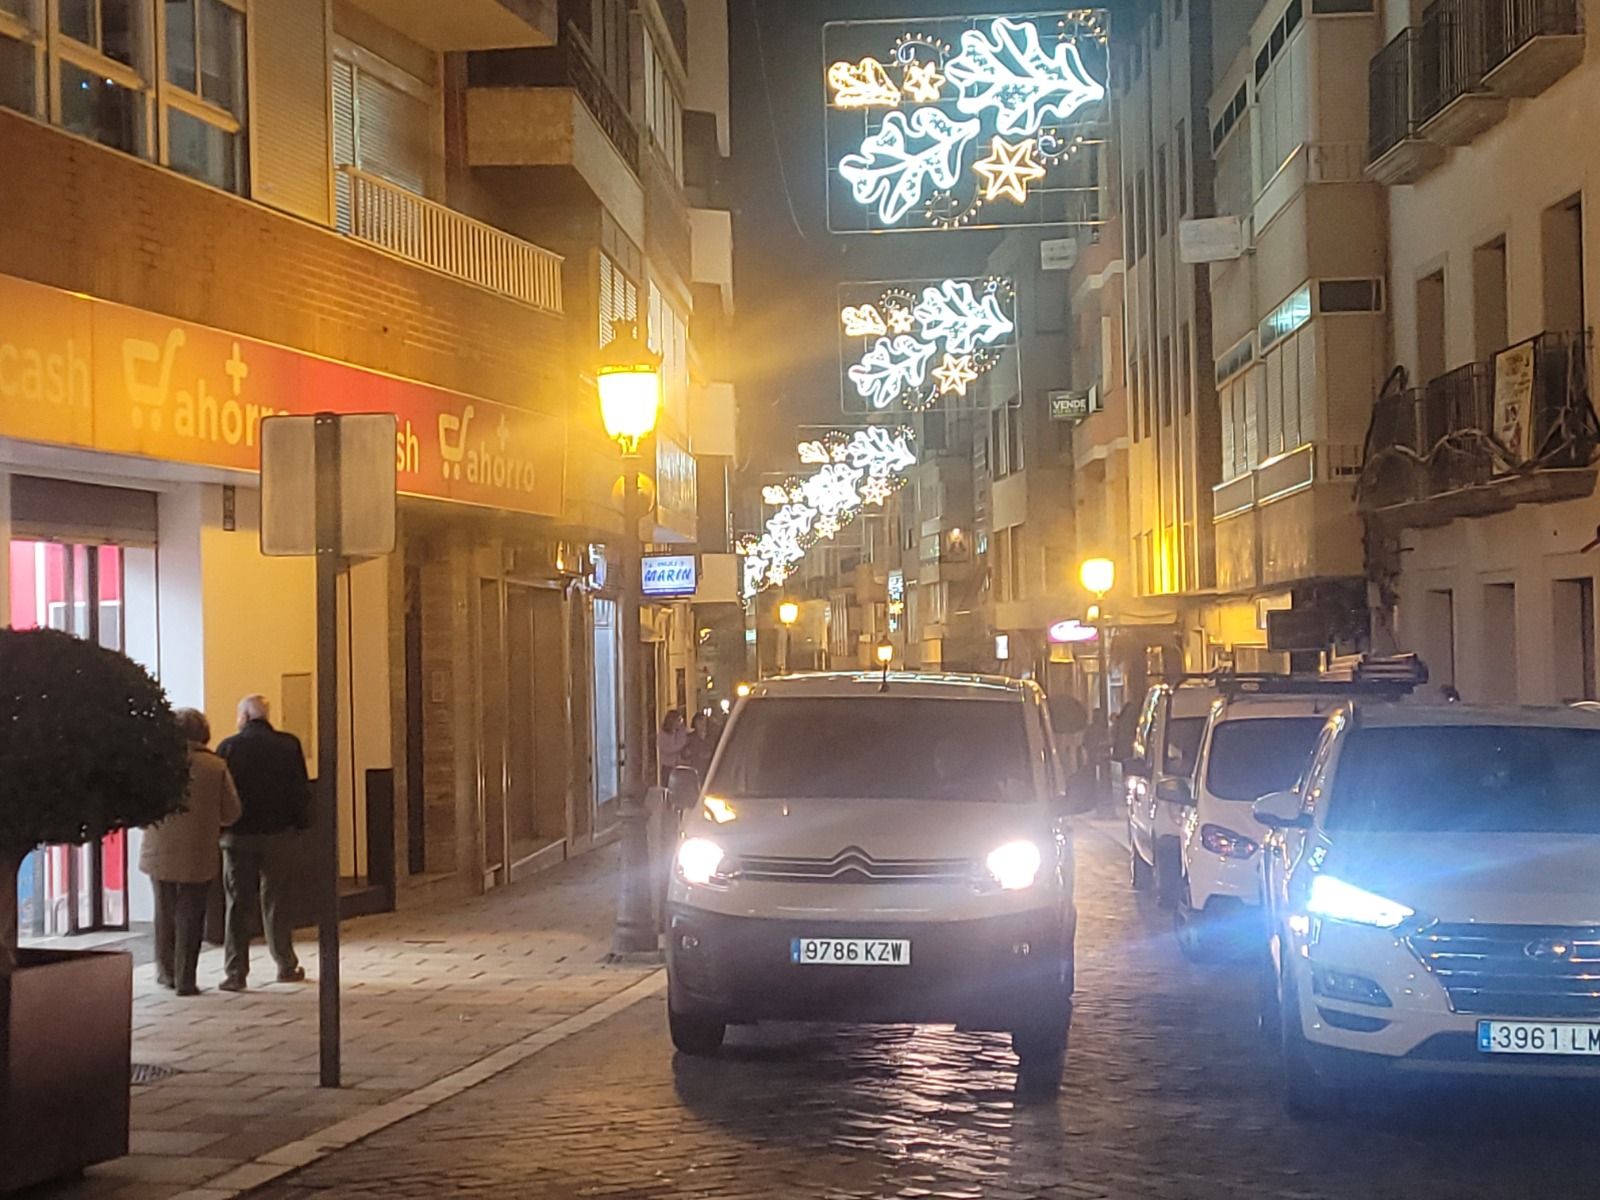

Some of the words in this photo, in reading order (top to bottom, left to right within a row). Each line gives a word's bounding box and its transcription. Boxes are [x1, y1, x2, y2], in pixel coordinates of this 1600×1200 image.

[174, 379, 289, 446] ahor
[467, 441, 536, 493] ahorro
[644, 568, 692, 582] MARIN
[806, 940, 859, 961] 9786
[864, 941, 902, 962] KZW
[1498, 1026, 1558, 1050] 3961
